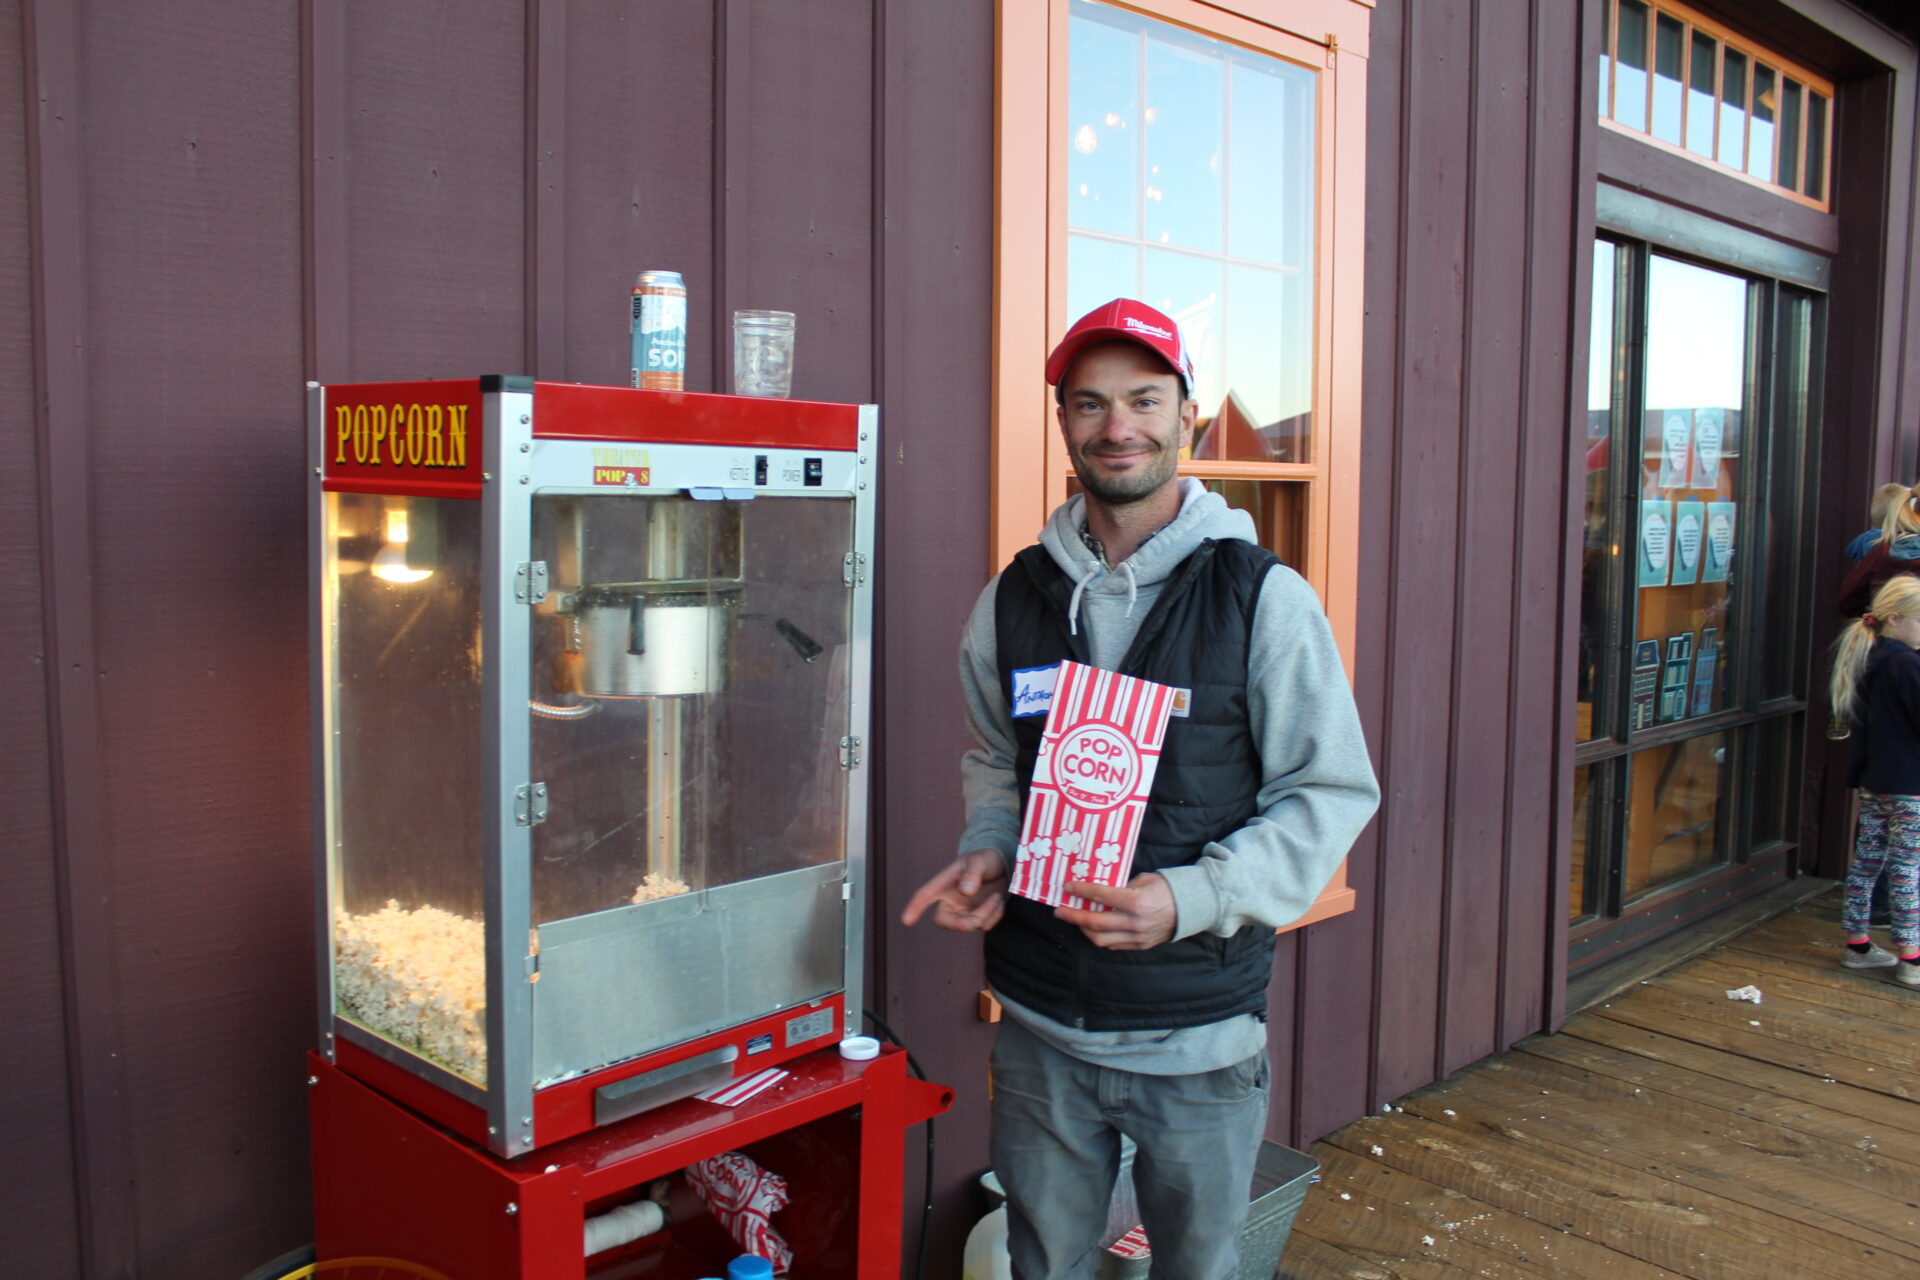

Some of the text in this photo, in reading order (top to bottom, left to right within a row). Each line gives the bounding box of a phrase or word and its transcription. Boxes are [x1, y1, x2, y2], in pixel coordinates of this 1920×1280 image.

[336, 403, 468, 467] POPCORN
[596, 469, 626, 483] POP
[1080, 738, 1123, 760] POP
[1064, 754, 1126, 787] CORN
[706, 1157, 747, 1195] CORN
